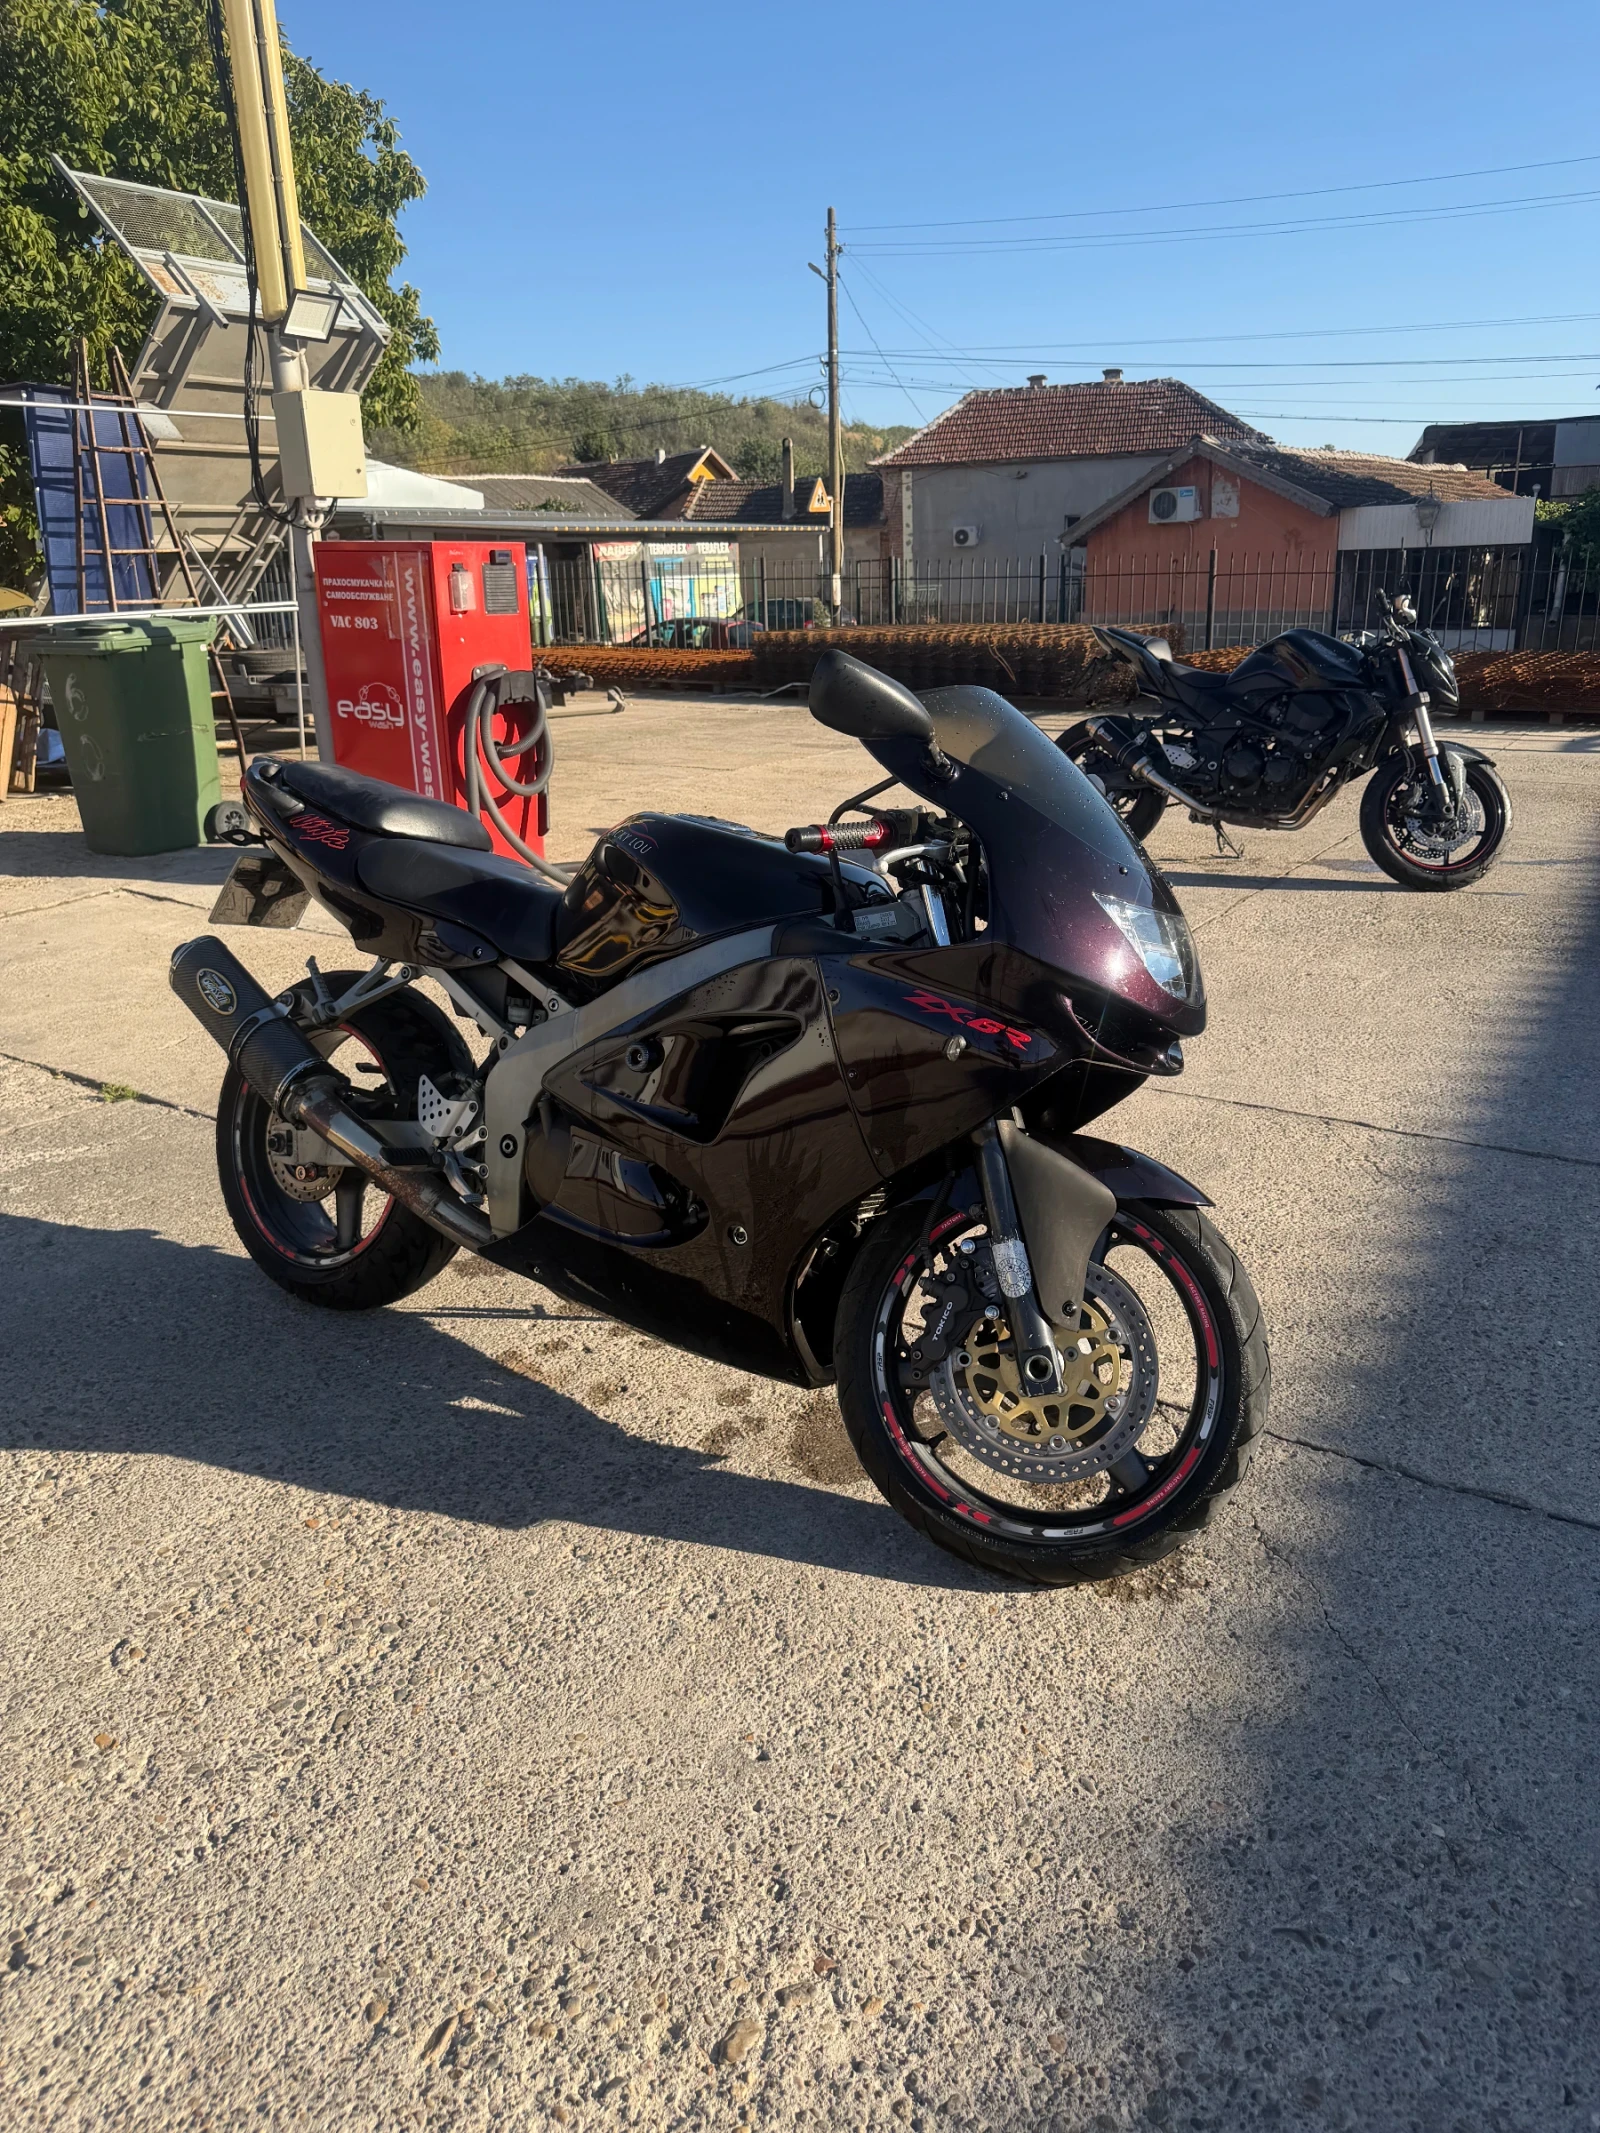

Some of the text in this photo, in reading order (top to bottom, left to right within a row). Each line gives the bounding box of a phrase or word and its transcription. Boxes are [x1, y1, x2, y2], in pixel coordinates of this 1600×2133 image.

[598, 544, 638, 557] RAIDER
[323, 578, 395, 588] ПРАХОСМУКАЧКА НА
[326, 591, 394, 601] САМООБСЛУЖВАНЕ
[330, 615, 378, 630] VAC 803
[337, 700, 405, 727] easy
[629, 838, 652, 853] LOU
[932, 1302, 953, 1341] TOKICO
